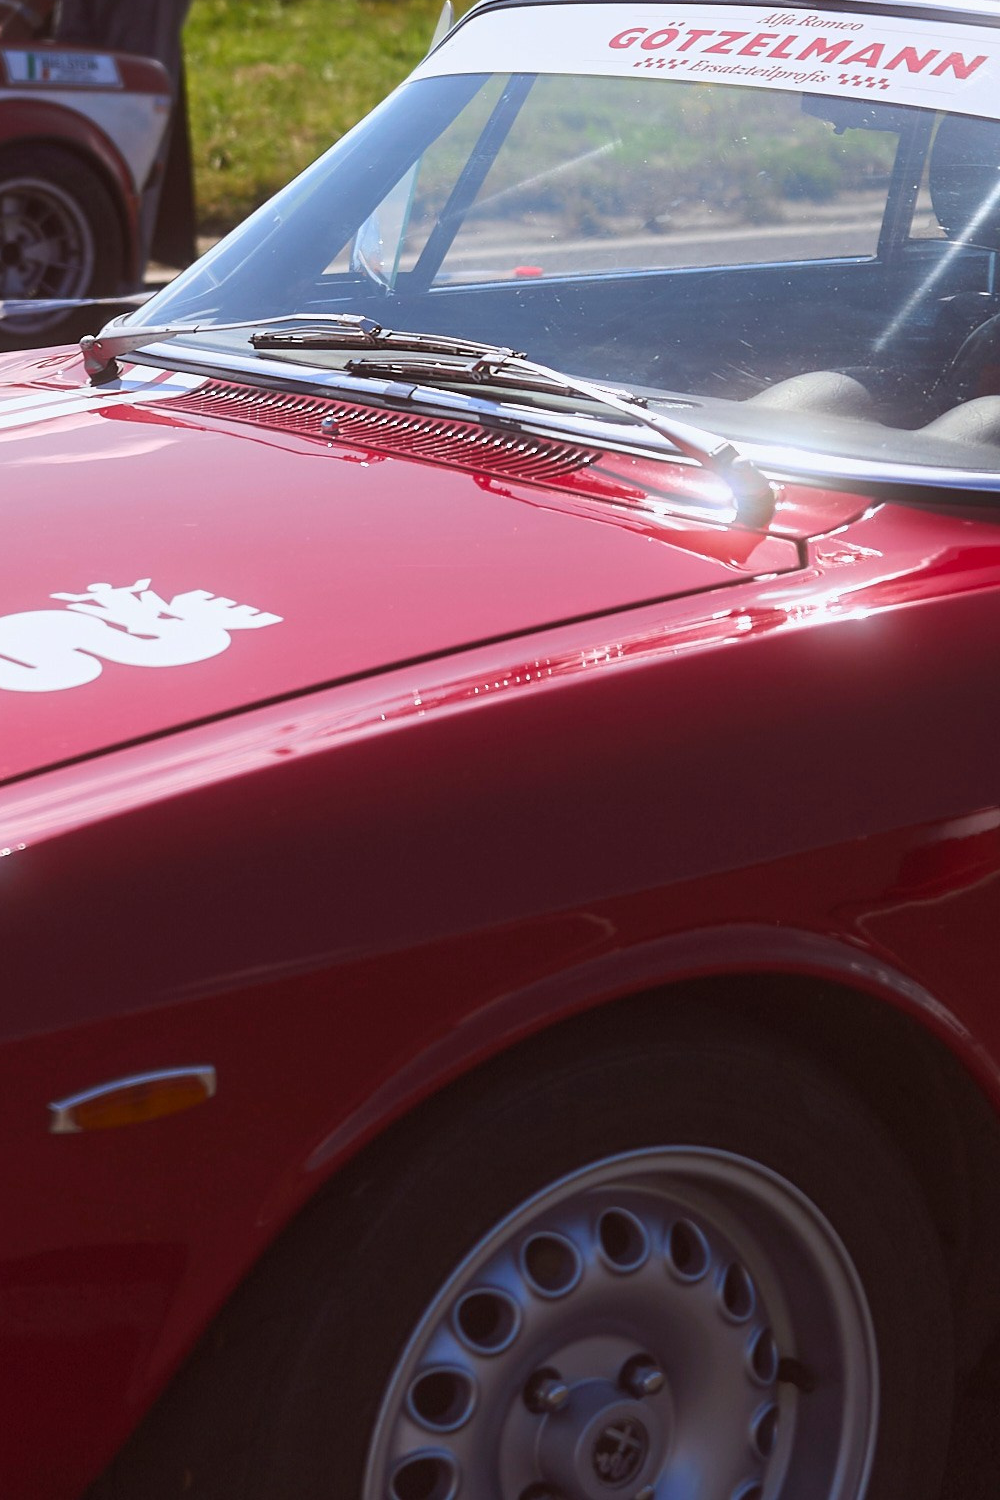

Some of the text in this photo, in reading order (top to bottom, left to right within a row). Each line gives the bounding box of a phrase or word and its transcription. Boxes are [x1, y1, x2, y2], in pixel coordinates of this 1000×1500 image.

[756, 12, 865, 31] Alfa Romeo
[608, 21, 989, 81] GÖTZELMANN
[687, 59, 831, 85] Ersatzteilprofis
